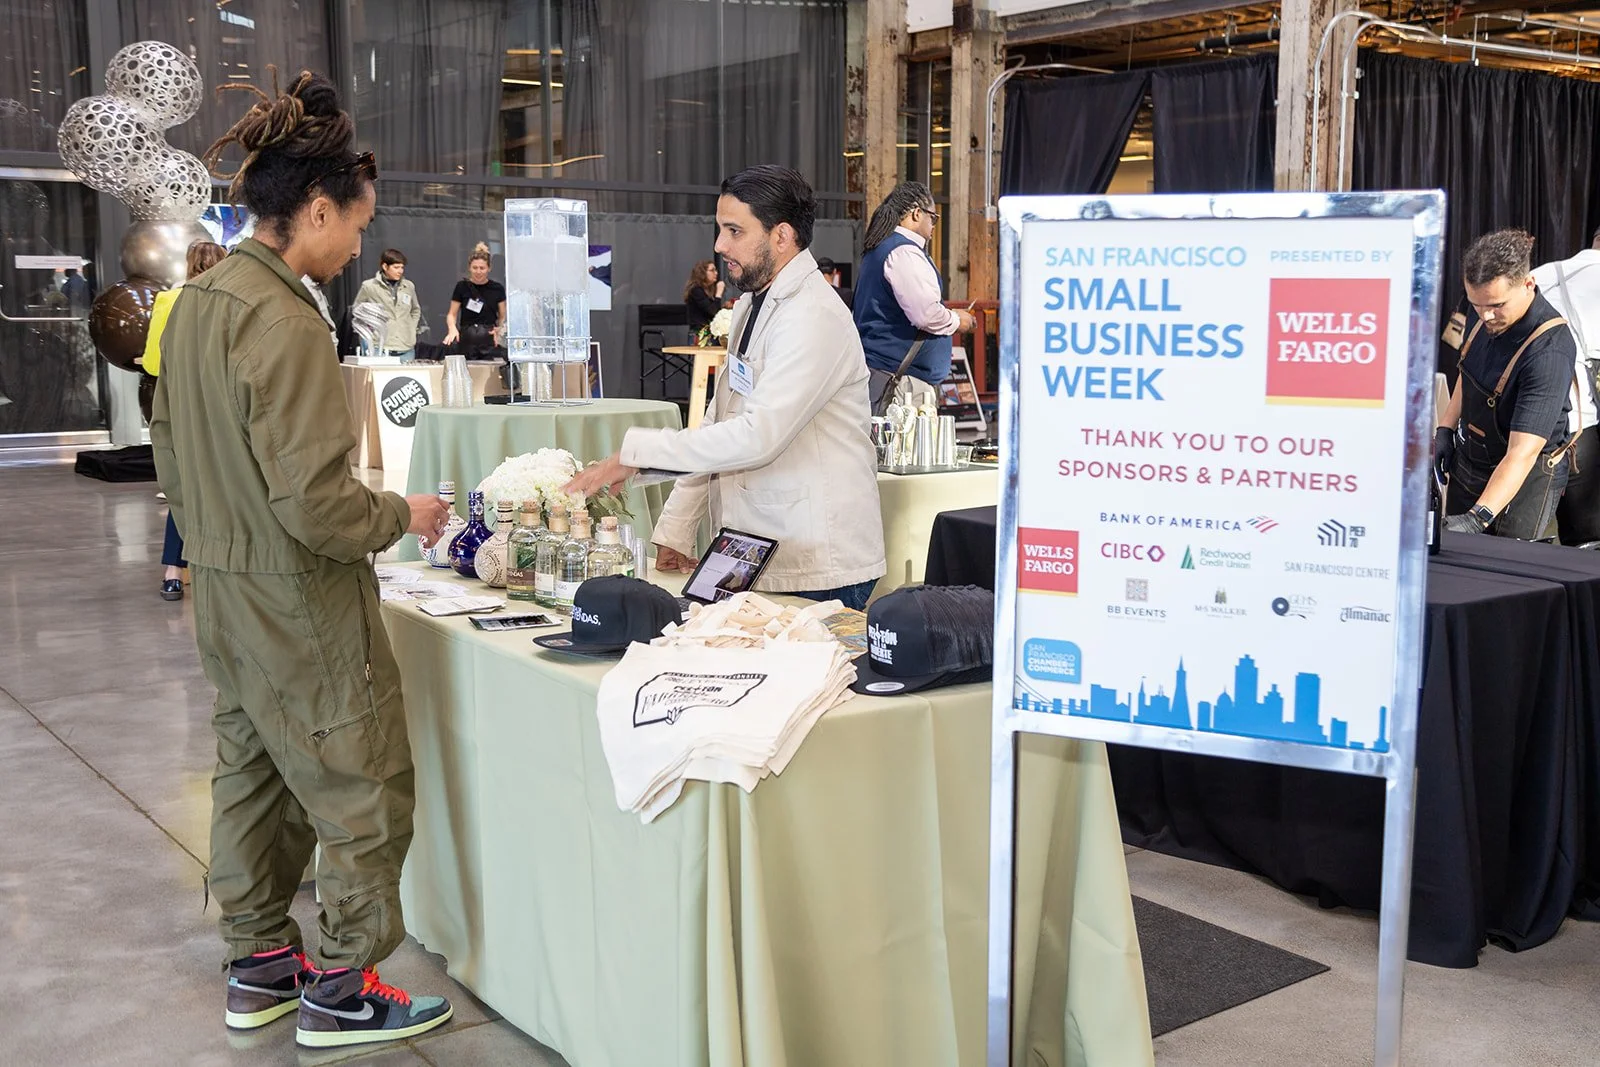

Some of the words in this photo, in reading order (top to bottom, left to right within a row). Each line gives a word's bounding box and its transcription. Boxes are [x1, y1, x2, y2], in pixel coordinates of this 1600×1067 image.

[1045, 246, 1095, 267] SAN
[1102, 246, 1247, 267] FRANCISCO
[1269, 250, 1366, 262] PRESENTED
[1370, 250, 1394, 262] BY
[1043, 277, 1182, 312] SMALL
[1276, 311, 1377, 336] WELLS
[1044, 322, 1245, 360] BUSINESS
[1277, 340, 1377, 364] FARGO
[1041, 364, 1166, 401] WEEK
[382, 380, 421, 413] FUTURE
[391, 394, 427, 424] FORMS
[1081, 428, 1164, 449] THANK
[1172, 431, 1225, 451] YOU
[1234, 435, 1269, 454] TO
[1278, 437, 1335, 457] OUR
[1058, 459, 1188, 484] SPONSORS
[1196, 467, 1211, 485] &
[1221, 468, 1358, 493] PARTNERS
[1100, 512, 1141, 525] BANK
[1146, 515, 1165, 526] OF
[1169, 517, 1242, 531] AMERICA
[1023, 543, 1074, 560] WELLS
[1101, 542, 1144, 561] CIBC
[1200, 547, 1251, 561] Redwood
[1024, 560, 1074, 575] FARGO
[1200, 558, 1224, 568] Credit
[1226, 560, 1251, 569] Union
[1284, 561, 1302, 573] SAN
[1304, 562, 1353, 577] FRANCISCO
[1355, 566, 1391, 580] CENTRE
[1107, 605, 1121, 614] BB
[1124, 607, 1167, 618] EVENTS
[1340, 606, 1391, 622] Almanac
[1028, 650, 1076, 662] FRANCISCO
[1028, 664, 1076, 676] COMMERCE
